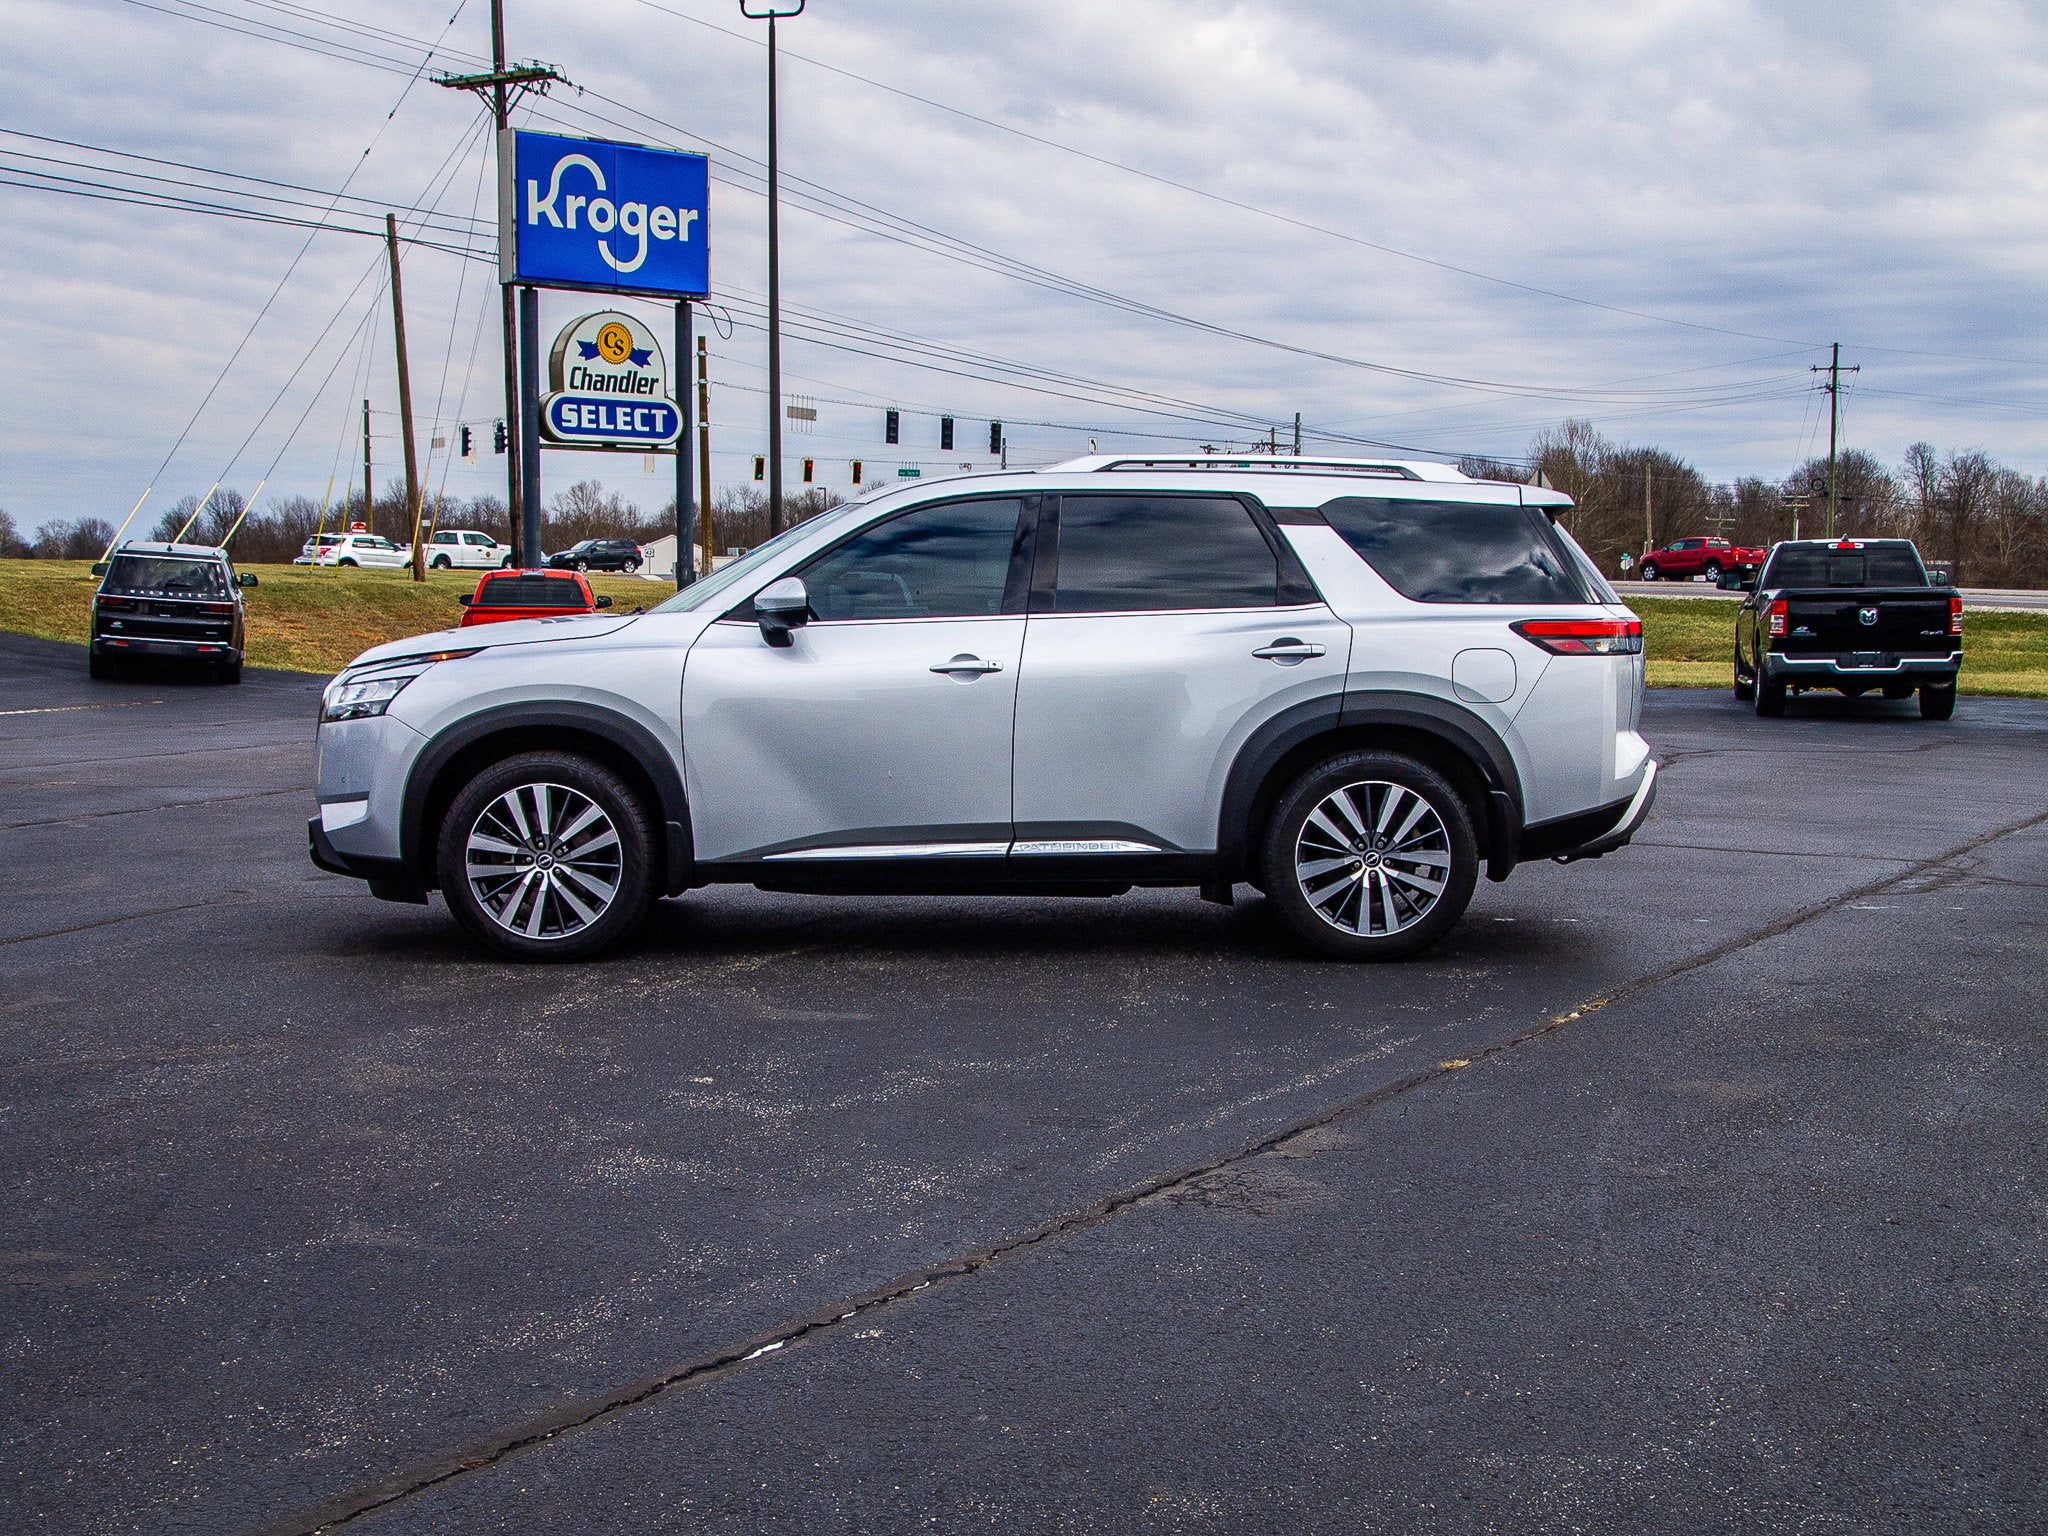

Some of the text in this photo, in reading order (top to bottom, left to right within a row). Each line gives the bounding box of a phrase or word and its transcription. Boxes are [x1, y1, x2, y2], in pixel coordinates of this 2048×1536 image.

[528, 153, 698, 273] Kroger
[569, 366, 659, 395] Chandler
[561, 403, 668, 432] SELECT
[1019, 842, 1122, 851] PATHFINDER
